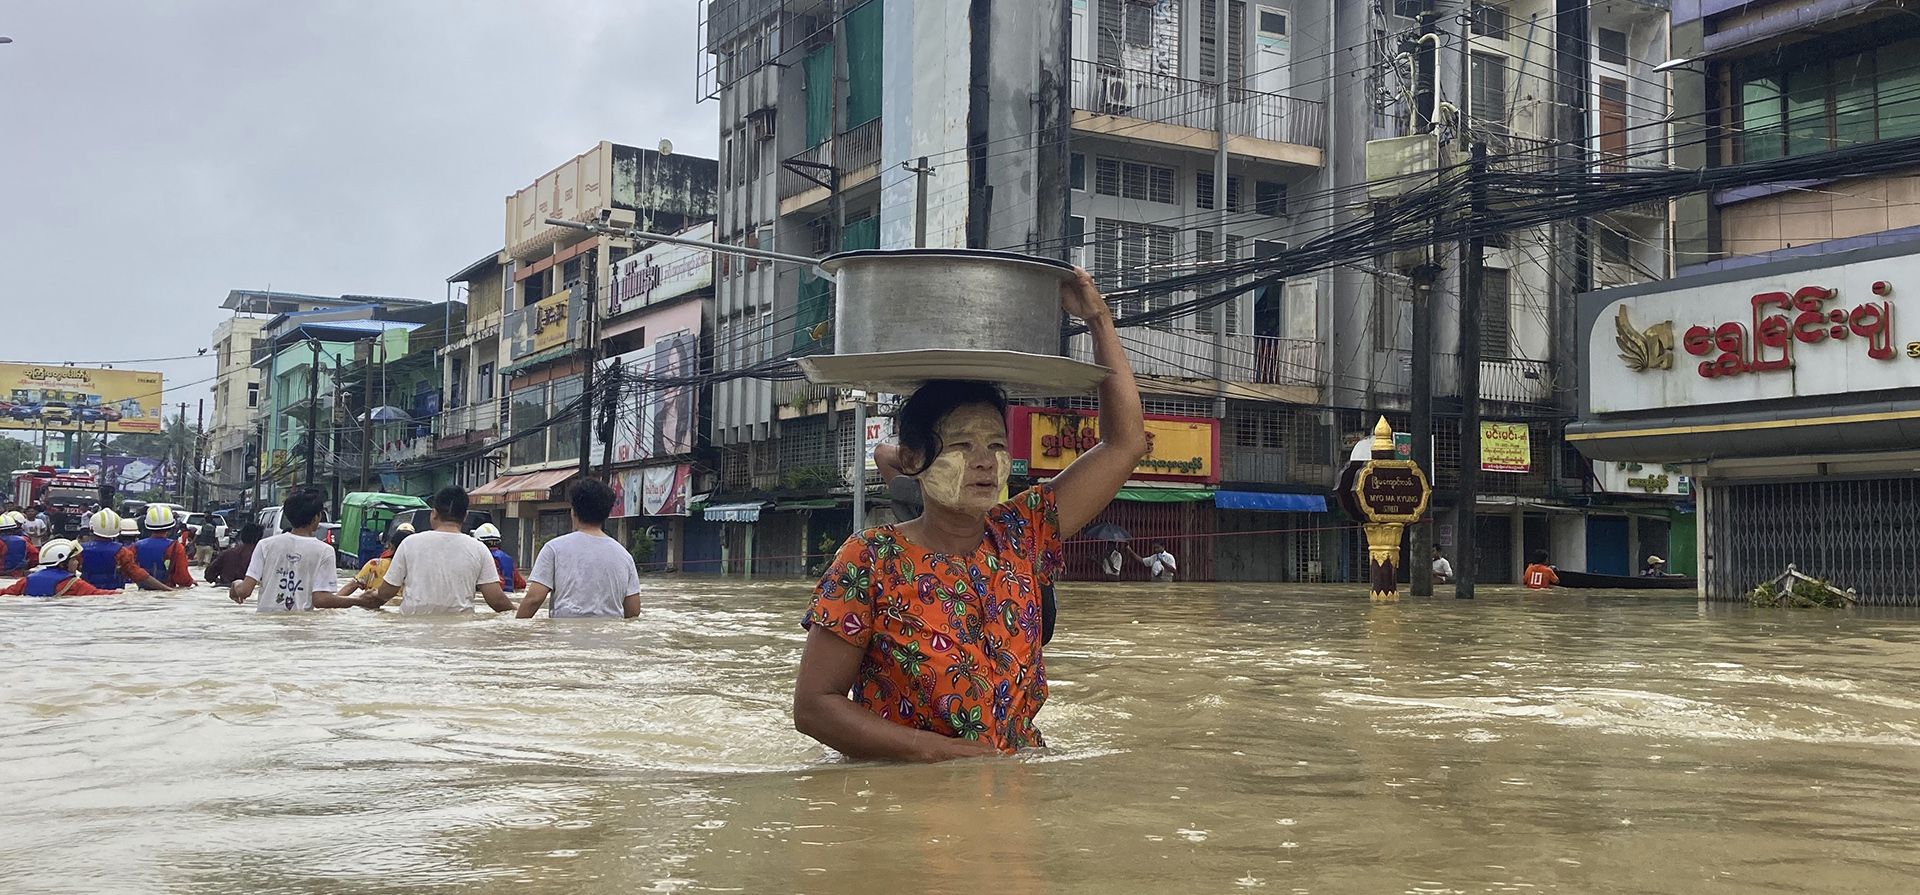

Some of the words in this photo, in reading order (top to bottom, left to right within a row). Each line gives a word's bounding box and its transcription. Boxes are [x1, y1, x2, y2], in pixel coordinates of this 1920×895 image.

[1683, 280, 1898, 379] ရွှေမြင်းပျံ
[1369, 494, 1384, 502] MYO
[1385, 494, 1396, 502] MA
[1396, 495, 1418, 503] KYUNG
[1530, 571, 1543, 586] 10
